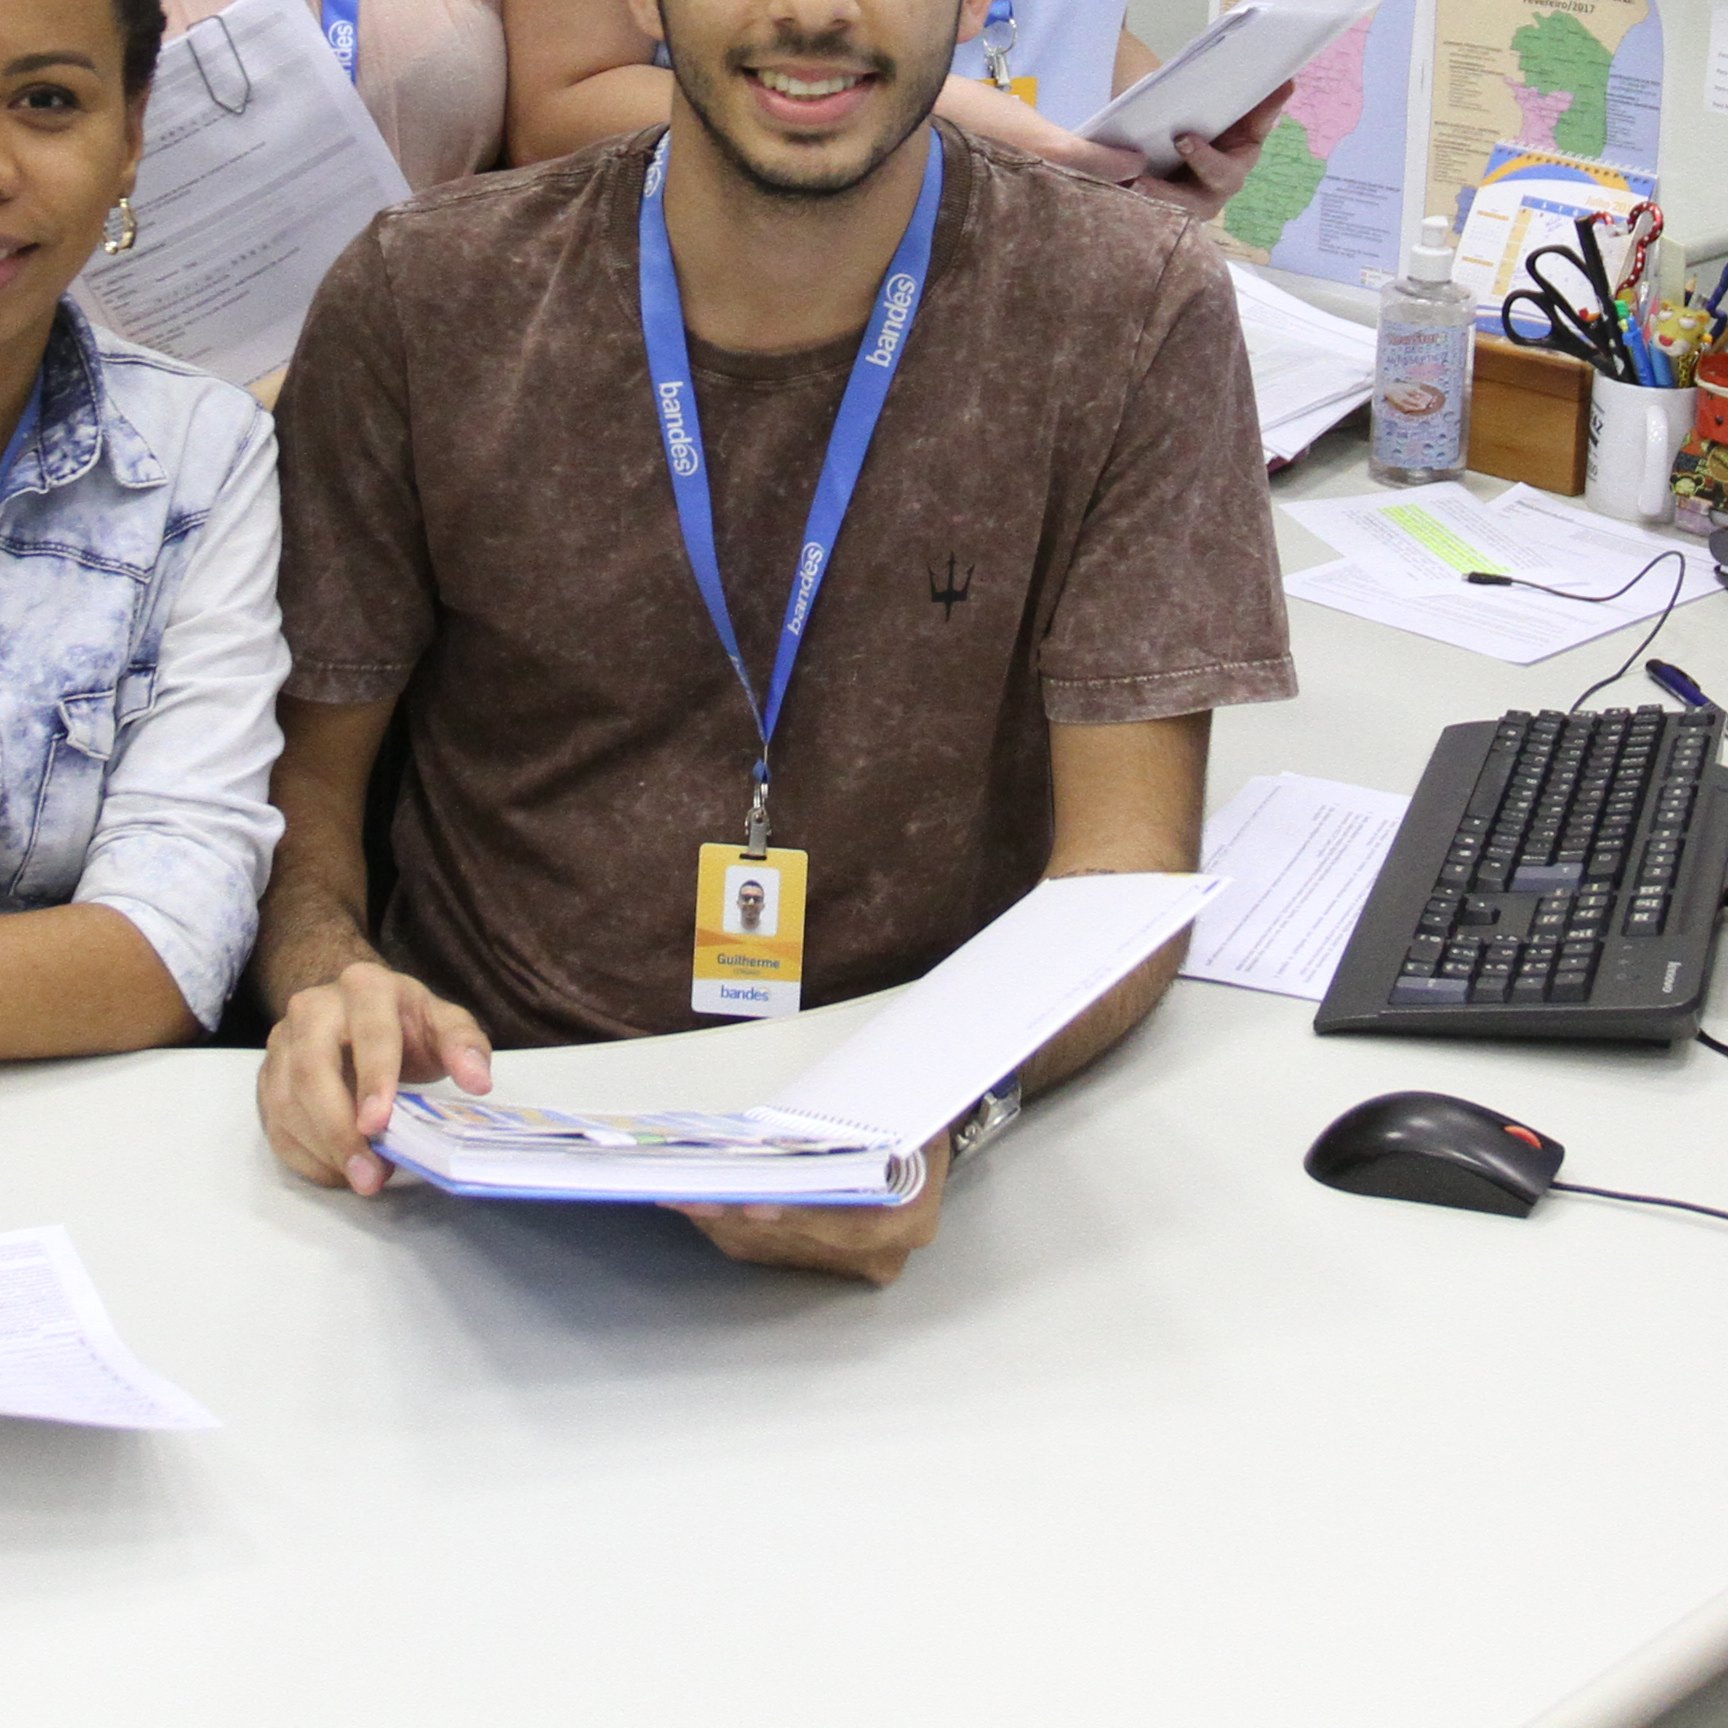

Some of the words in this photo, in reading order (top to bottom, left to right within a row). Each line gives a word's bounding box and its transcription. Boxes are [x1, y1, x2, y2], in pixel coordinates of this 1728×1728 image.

[866, 273, 916, 368] bandes
[658, 381, 699, 478] bandes
[787, 541, 824, 636] bandes
[717, 953, 780, 969] Guilherme
[1662, 961, 1682, 993] lenovo
[721, 984, 770, 1002] bandes
